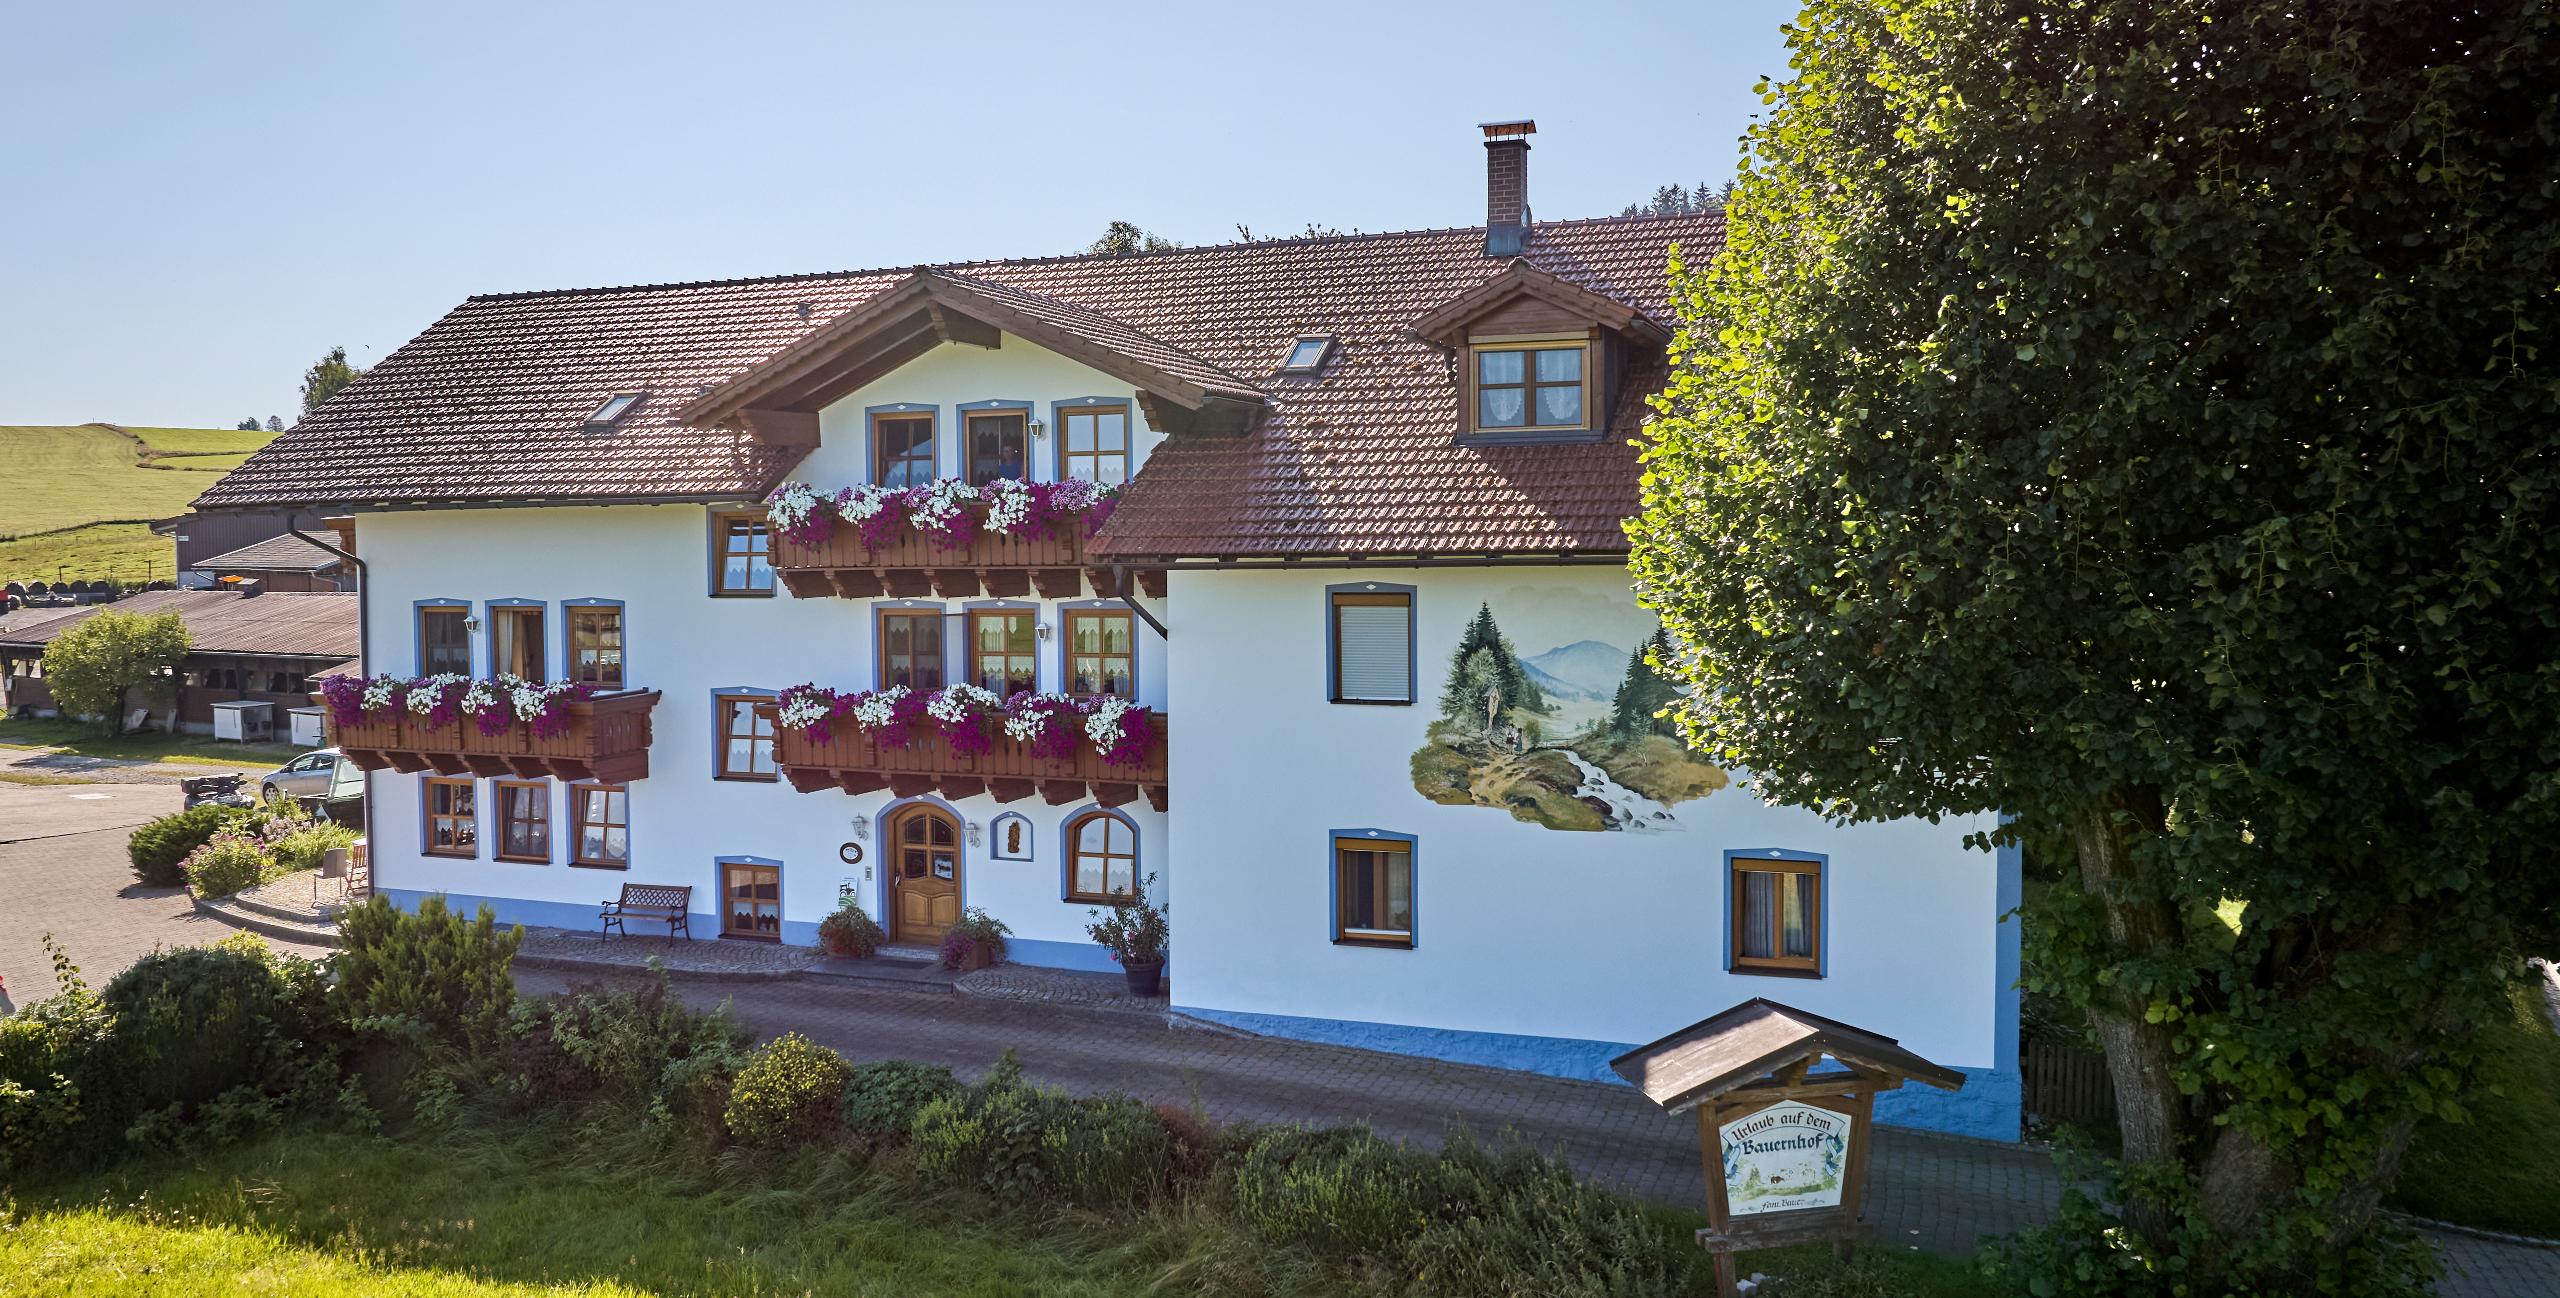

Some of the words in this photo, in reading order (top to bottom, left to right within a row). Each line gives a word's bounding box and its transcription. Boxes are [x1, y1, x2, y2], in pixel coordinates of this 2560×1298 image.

[1731, 1115, 1774, 1141] Urlaub
[1780, 1111, 1804, 1125] auf
[1806, 1113, 1831, 1131] dem
[1742, 1133, 1824, 1155] Bauernhof
